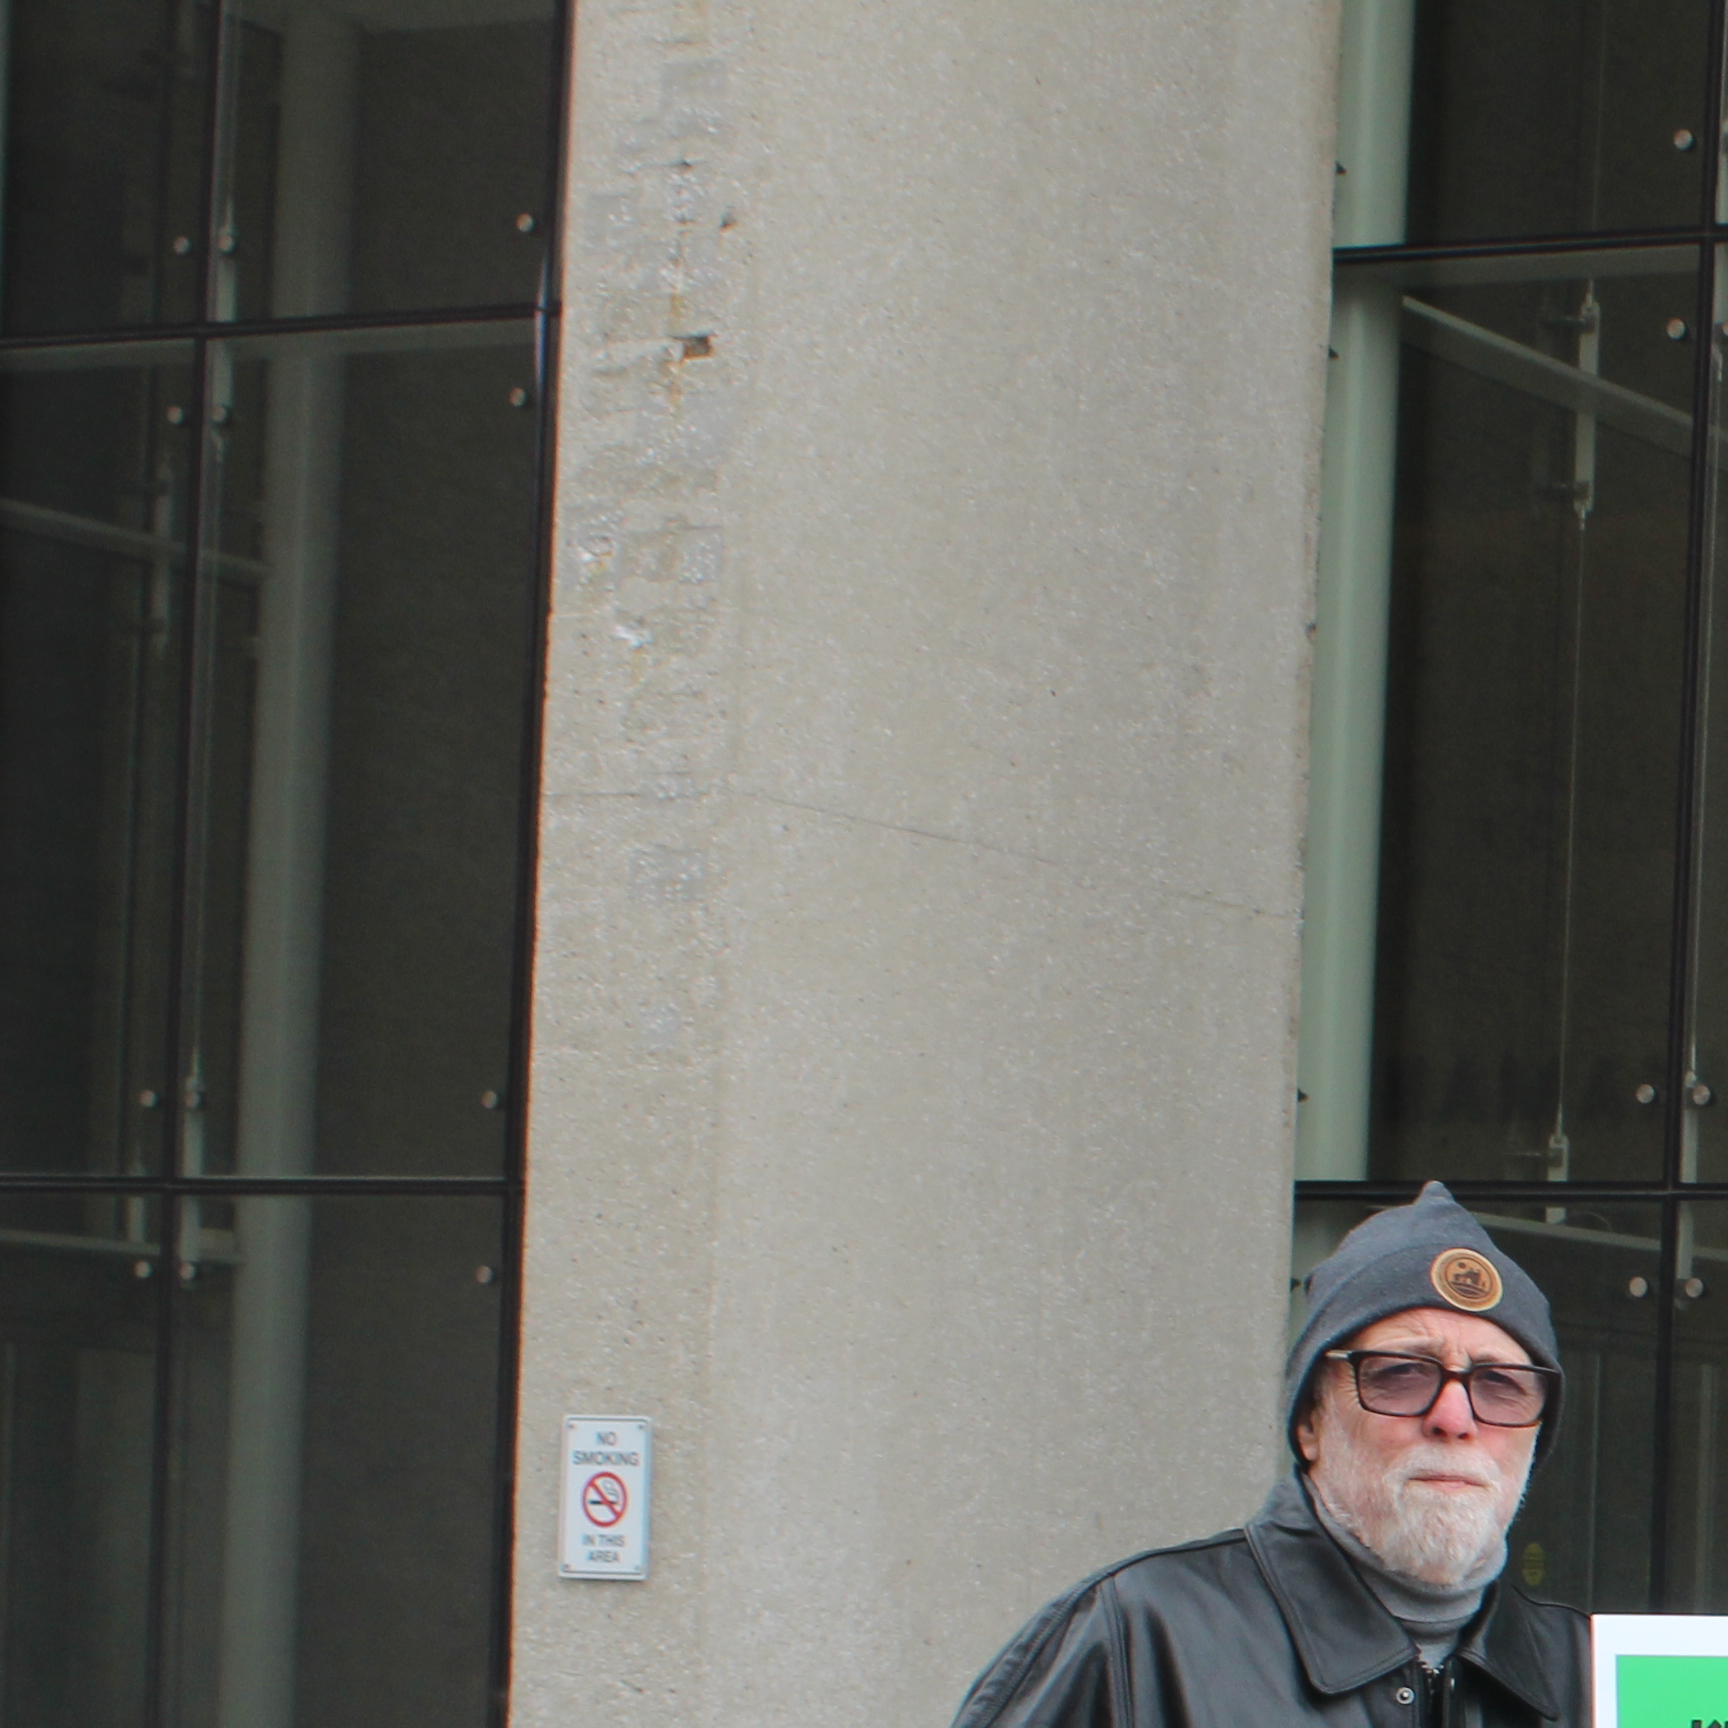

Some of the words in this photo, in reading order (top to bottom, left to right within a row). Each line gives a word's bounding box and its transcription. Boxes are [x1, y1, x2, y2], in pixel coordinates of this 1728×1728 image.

[597, 1431, 618, 1446] NO
[573, 1450, 640, 1466] SMOKING
[582, 1534, 596, 1546] IN
[598, 1534, 625, 1547] THIS
[588, 1550, 620, 1563] AREA
